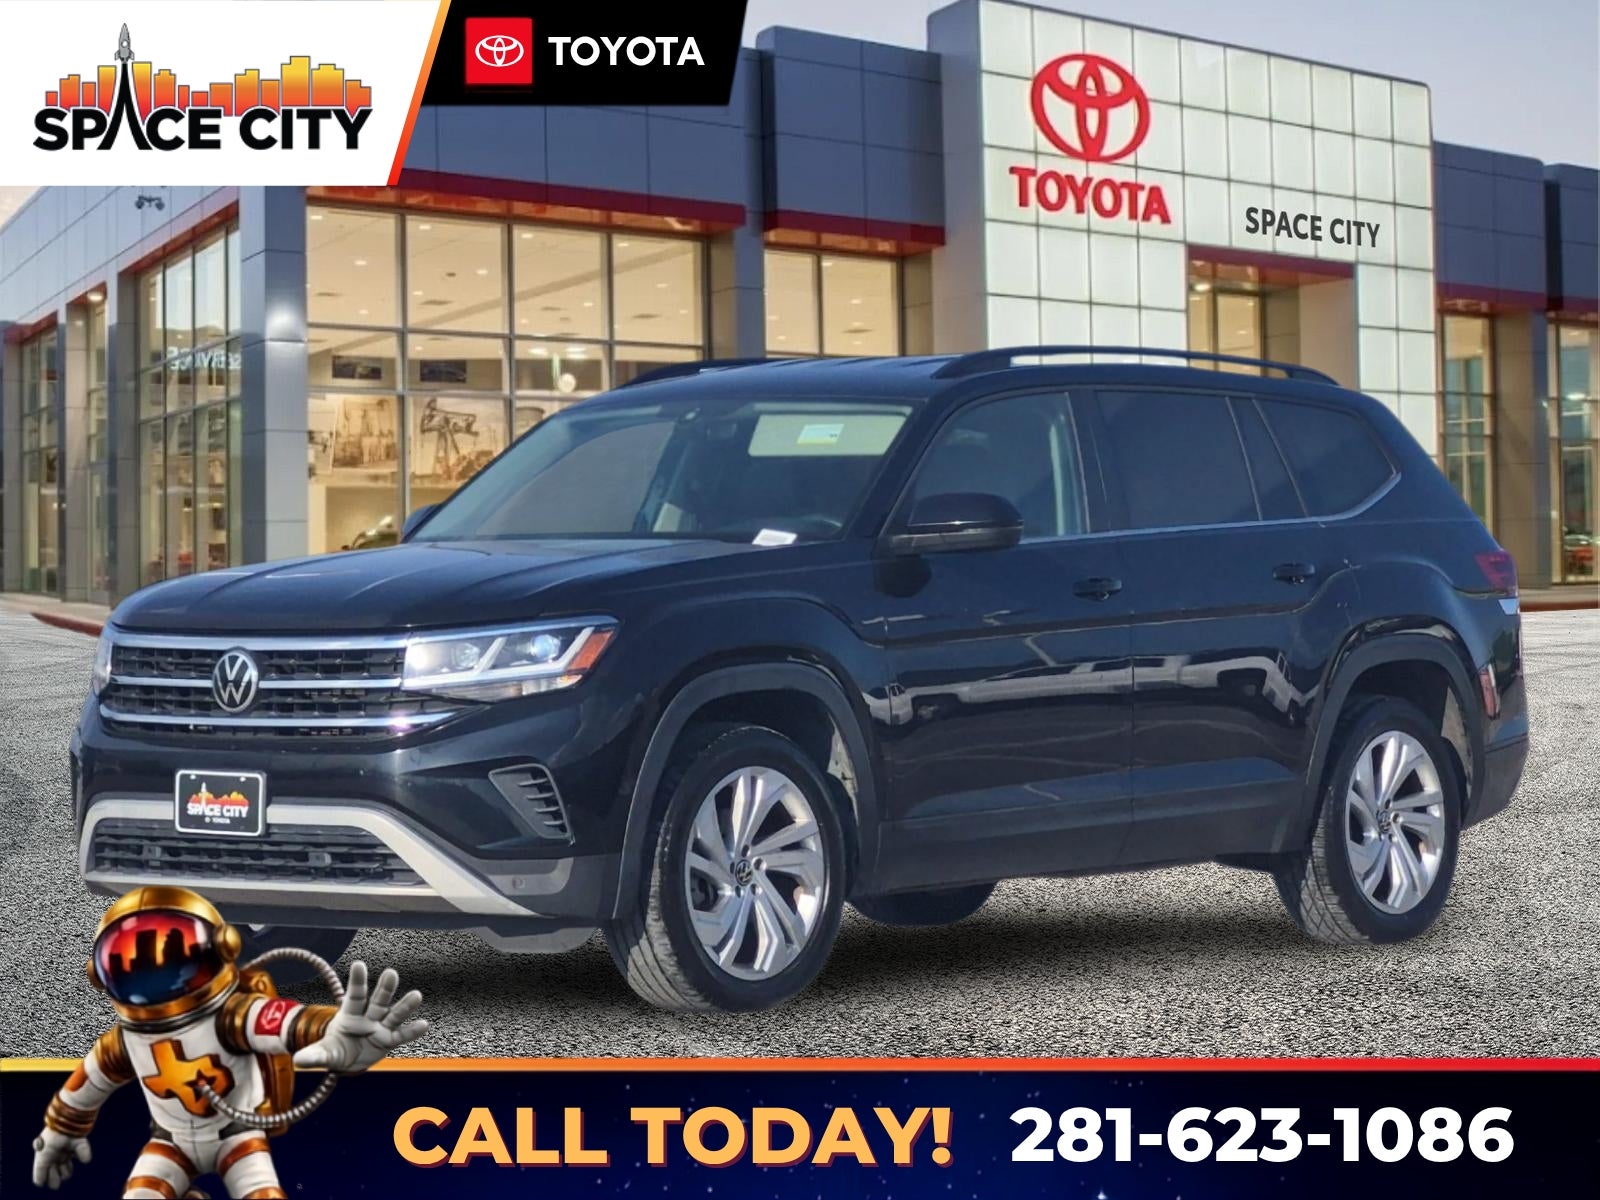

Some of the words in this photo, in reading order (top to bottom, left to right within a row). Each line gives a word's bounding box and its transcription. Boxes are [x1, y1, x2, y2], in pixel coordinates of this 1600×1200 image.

[1009, 166, 1171, 224] TOYOTA
[1245, 206, 1322, 242] SPACE
[1329, 218, 1380, 248] CITY
[187, 801, 221, 817] SPACE
[222, 805, 249, 818] CITY
